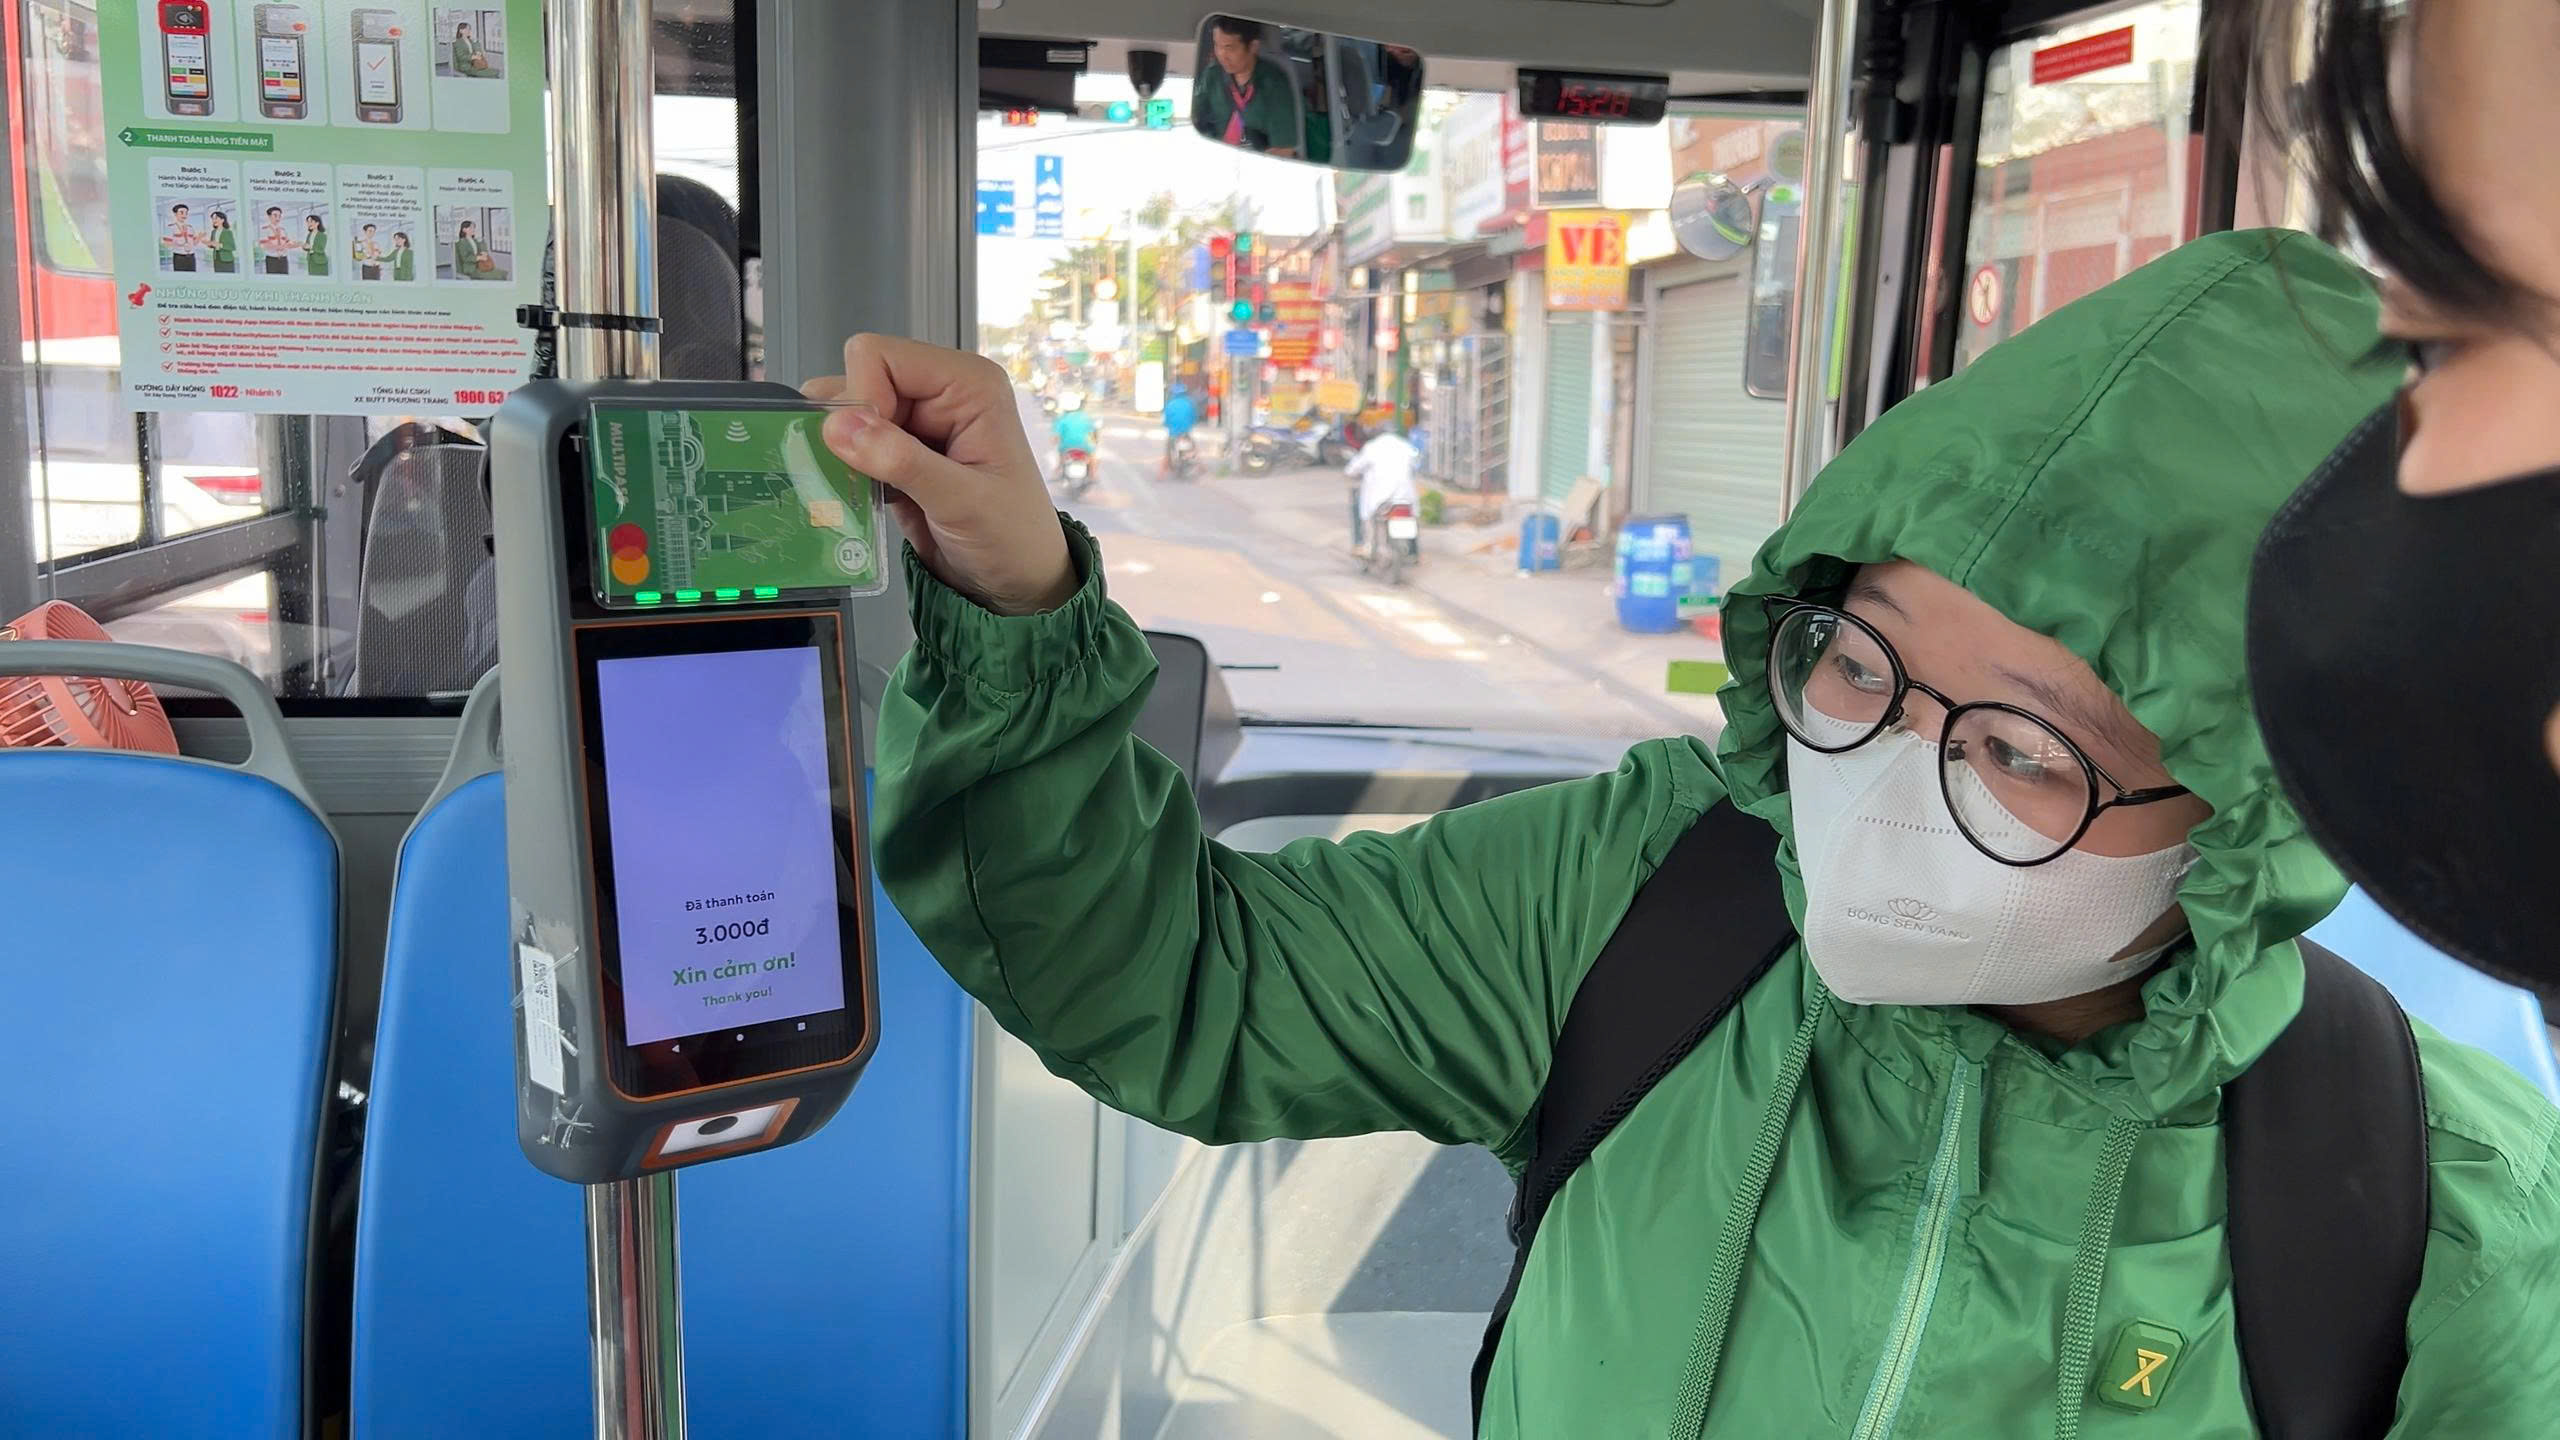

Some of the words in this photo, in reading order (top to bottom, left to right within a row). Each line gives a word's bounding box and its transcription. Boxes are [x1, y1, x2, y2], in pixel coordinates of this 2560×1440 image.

[124, 131, 132, 142] 2
[146, 134, 177, 142] THANH
[177, 134, 203, 144] TOÁN
[209, 385, 239, 399] 1022
[453, 391, 485, 404] 1900
[685, 899, 703, 912] Đã
[705, 894, 743, 909] thanh
[746, 890, 775, 904] toán
[695, 918, 770, 945] 3.000đ
[1894, 918, 1924, 931] SEN
[672, 966, 707, 986] Xin
[713, 959, 757, 980] cảm
[763, 951, 796, 972] ơn!
[702, 990, 743, 1007] Thank
[746, 986, 773, 1002] you!
